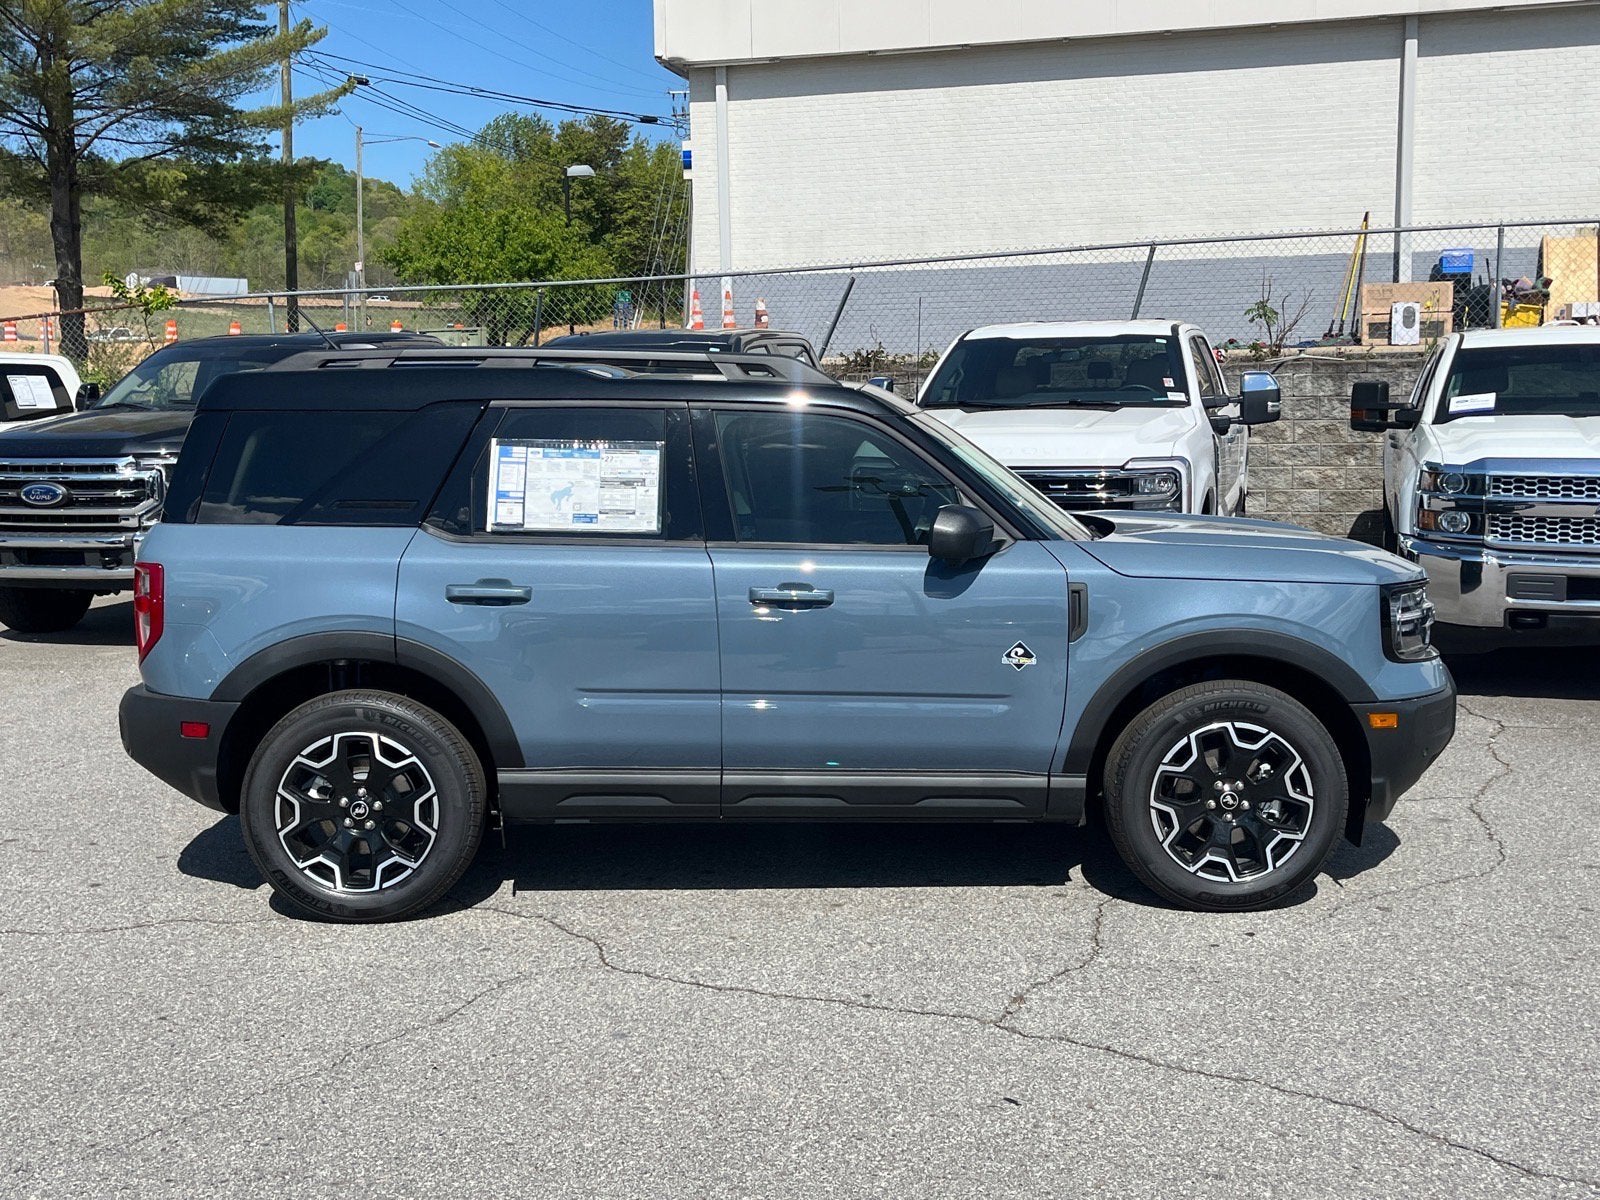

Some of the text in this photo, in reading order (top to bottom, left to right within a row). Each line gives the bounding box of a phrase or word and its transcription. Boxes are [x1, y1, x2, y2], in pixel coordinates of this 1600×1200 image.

[29, 488, 54, 501] Ford
[1203, 700, 1267, 713] MICHELIN
[384, 716, 439, 755] MICHELIN
